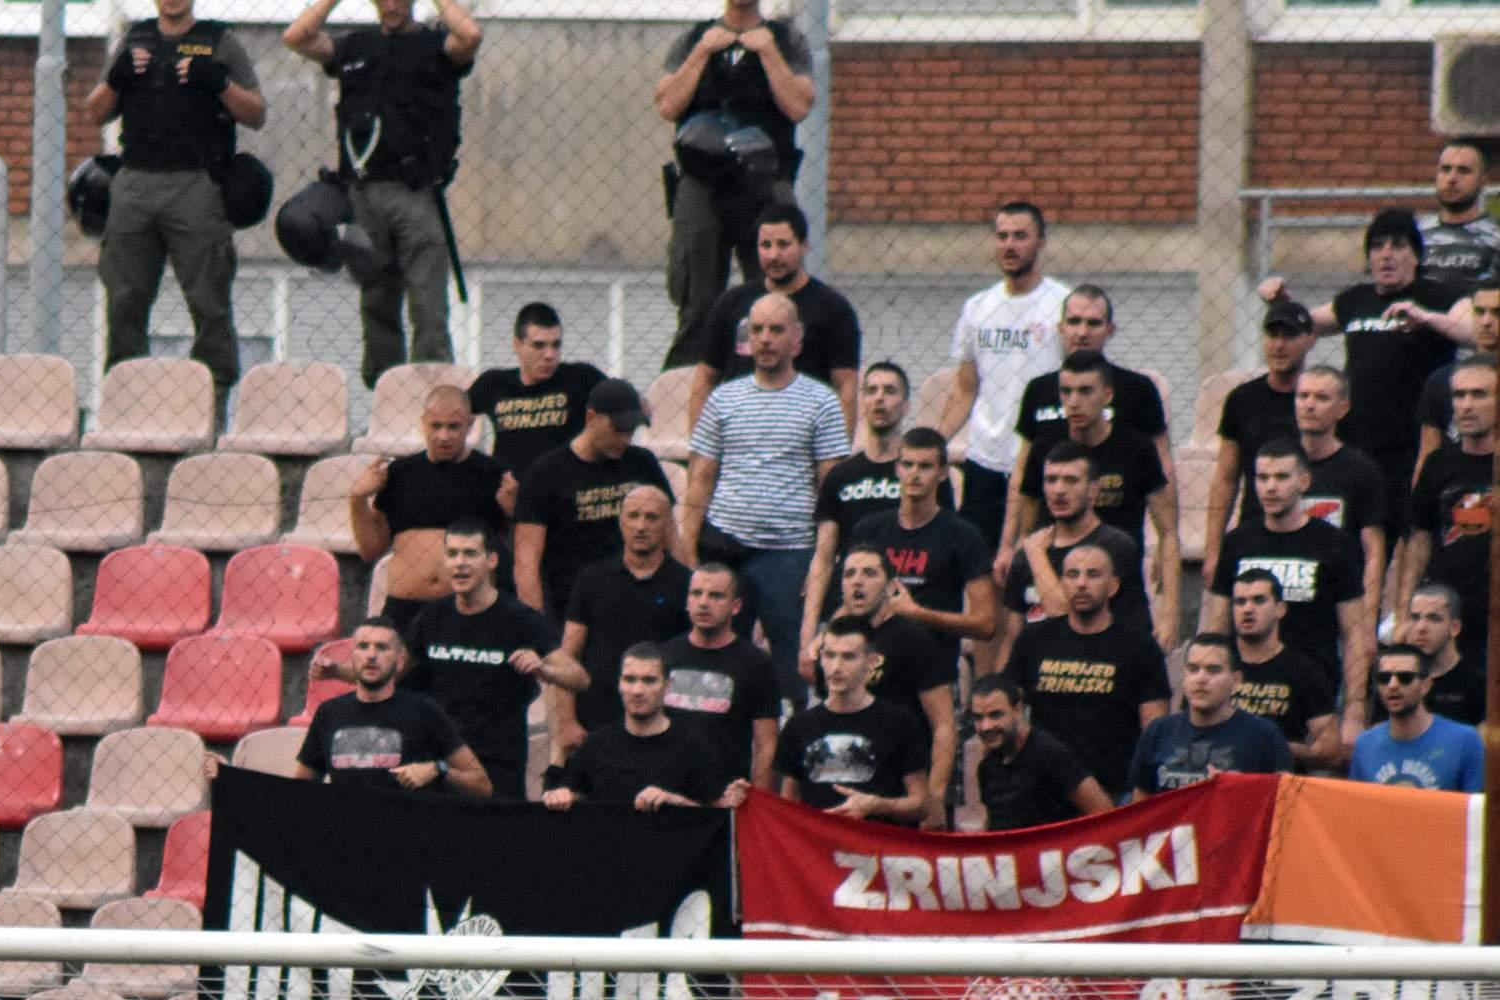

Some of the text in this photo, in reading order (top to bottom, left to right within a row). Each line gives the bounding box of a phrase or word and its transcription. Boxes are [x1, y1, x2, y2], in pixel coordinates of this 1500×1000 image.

[978, 327, 1031, 350] ULTRAS
[840, 478, 902, 501] adida
[428, 645, 505, 666] ULTRAS
[1039, 660, 1116, 678] NAPRIJED
[1036, 676, 1114, 694] ZRINJSKI
[833, 824, 1199, 911] ZRINJSKI
